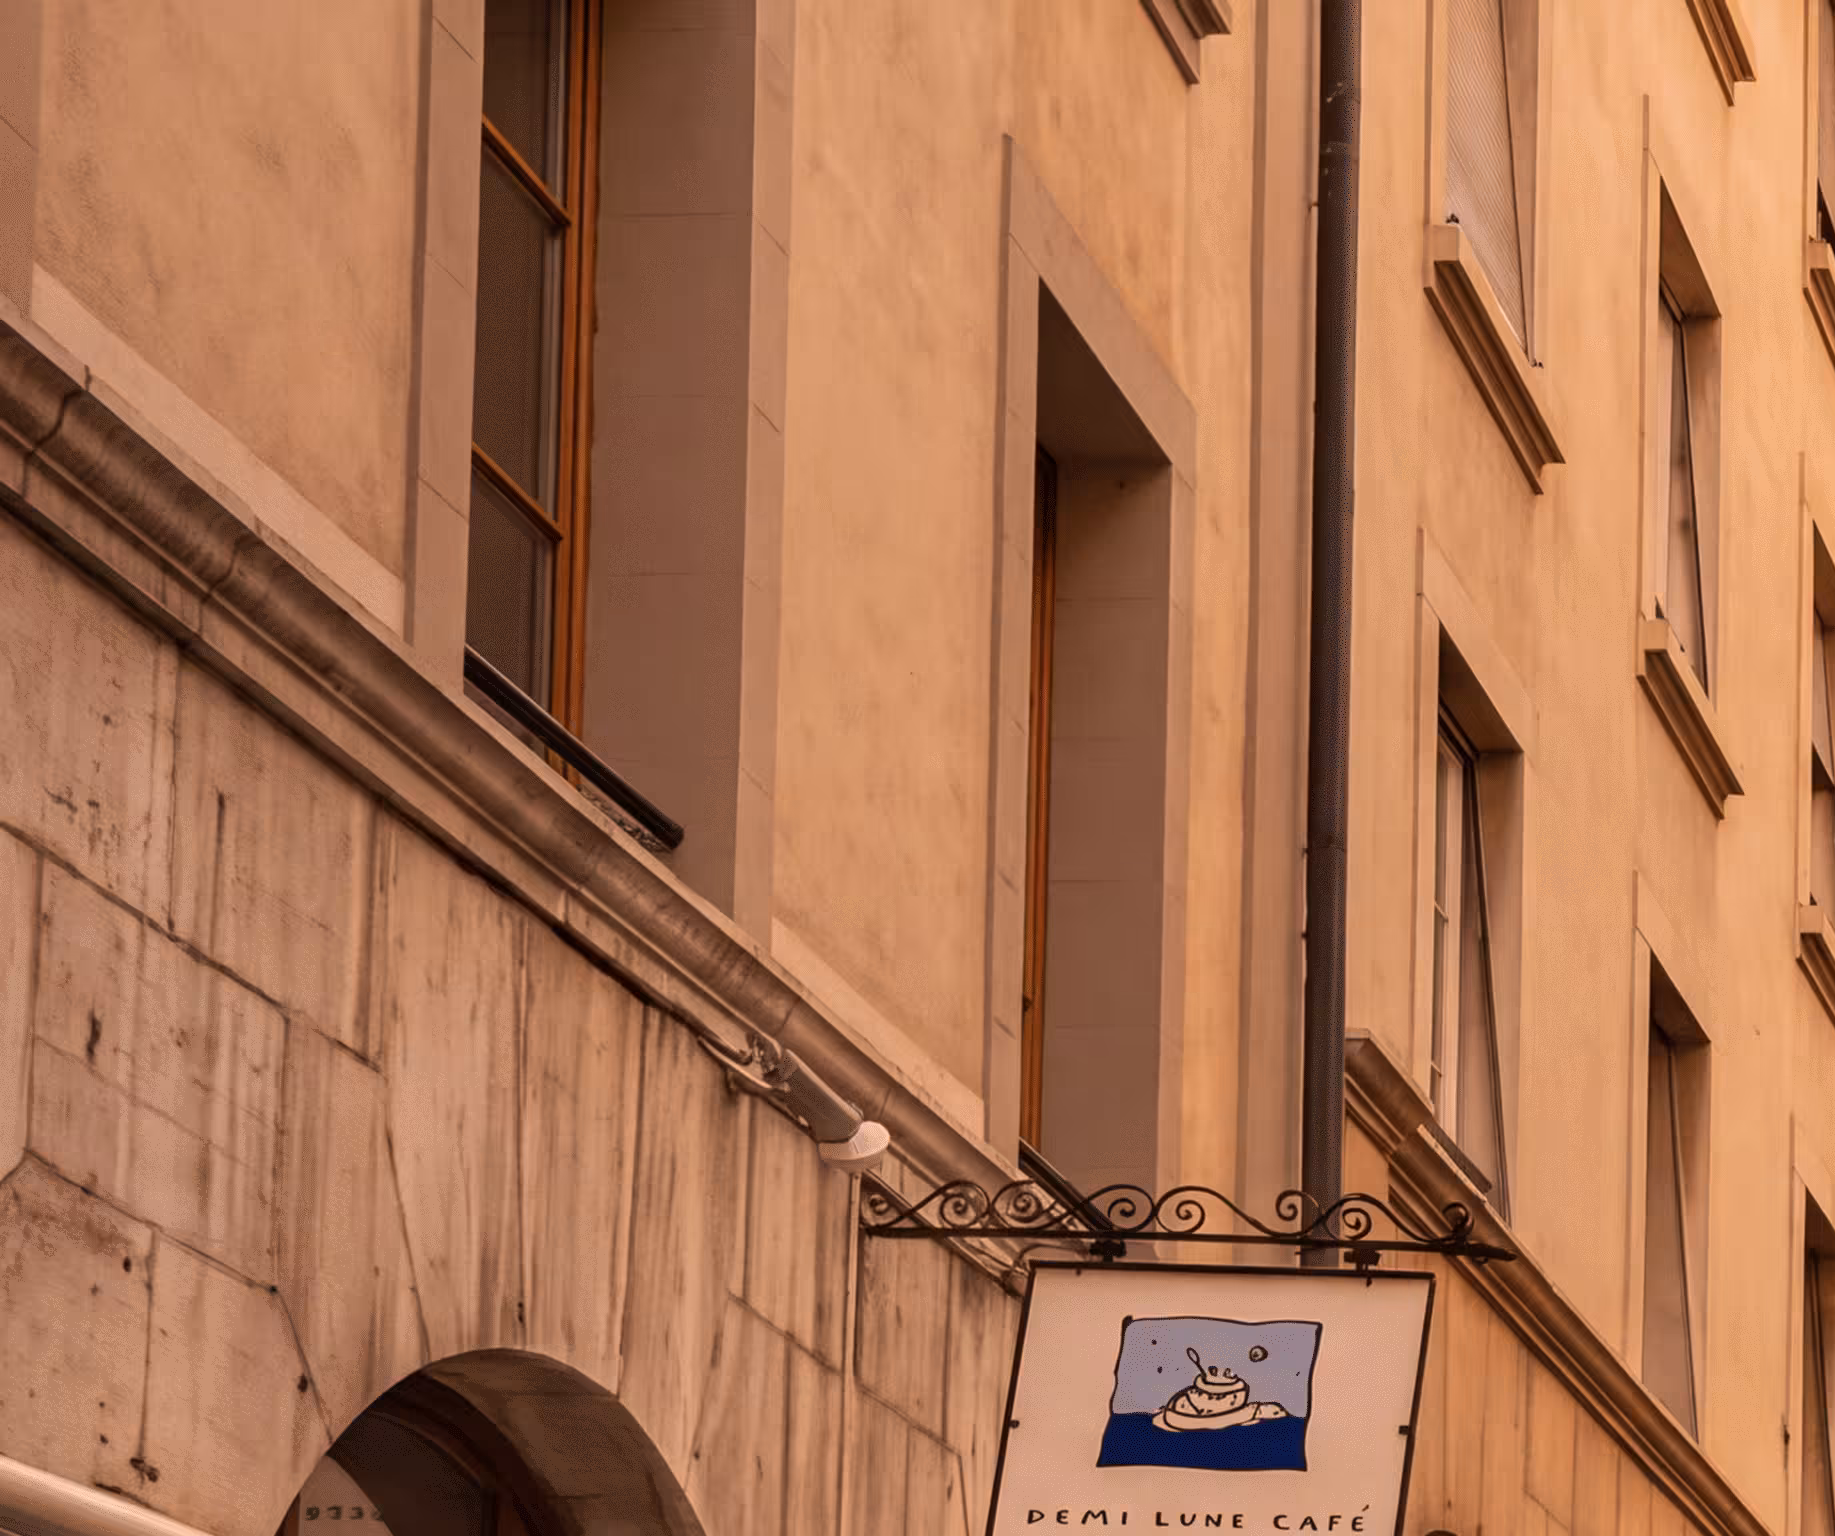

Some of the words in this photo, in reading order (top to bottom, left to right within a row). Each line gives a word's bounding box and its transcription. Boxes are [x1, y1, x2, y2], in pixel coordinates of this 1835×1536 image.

[1026, 1508, 1128, 1526] DEMI
[1155, 1510, 1245, 1529] LUNE
[1272, 1503, 1371, 1533] CAFÉ
